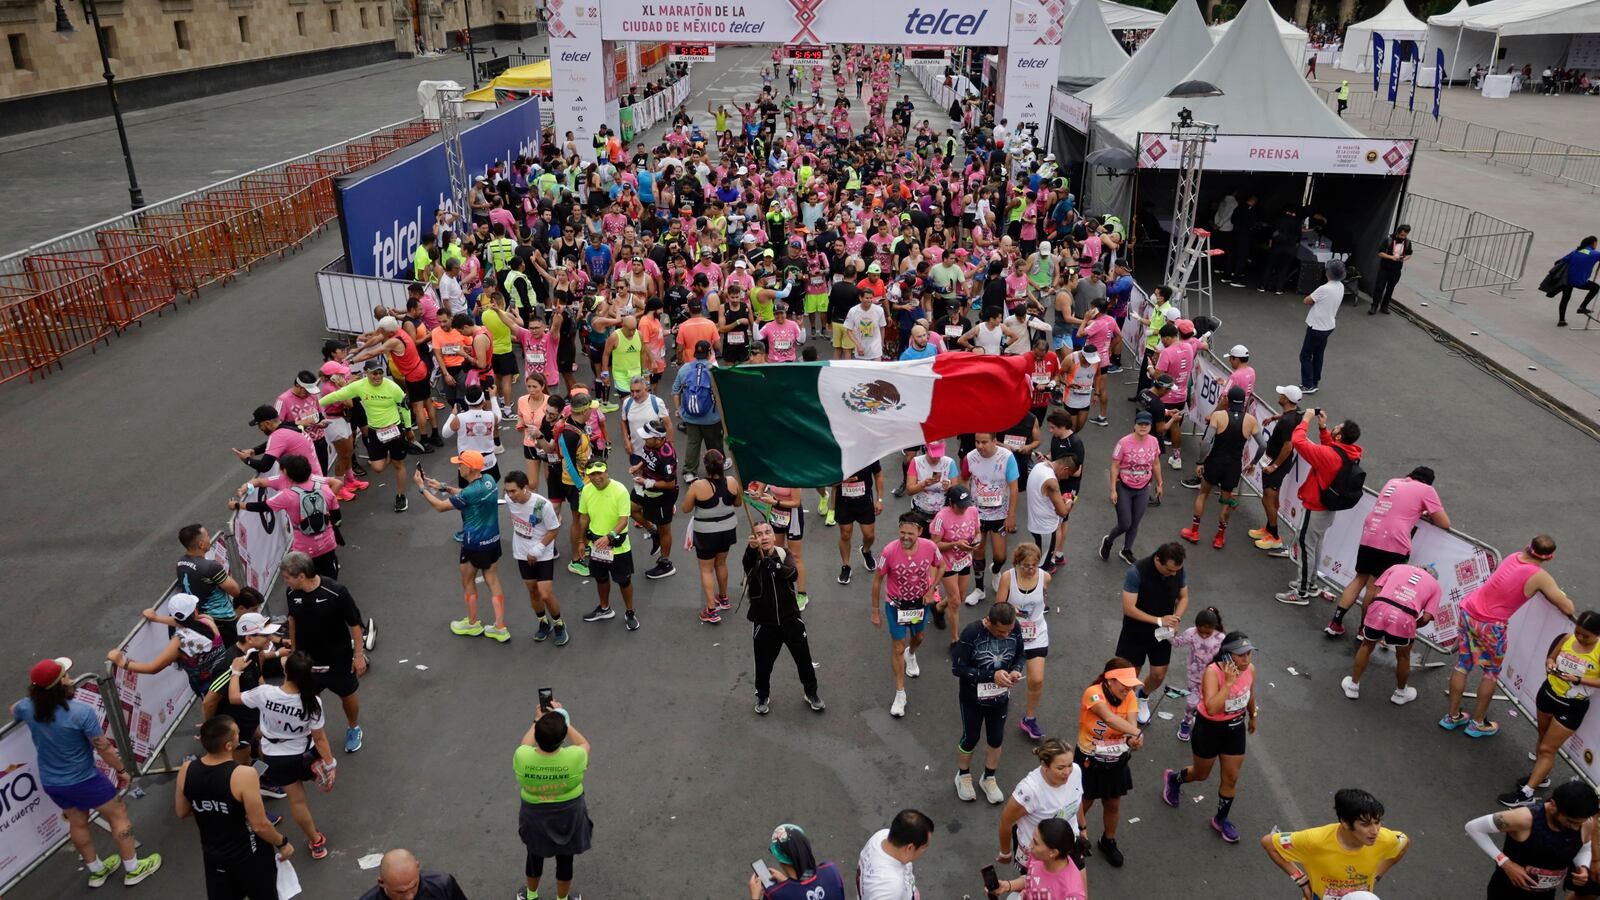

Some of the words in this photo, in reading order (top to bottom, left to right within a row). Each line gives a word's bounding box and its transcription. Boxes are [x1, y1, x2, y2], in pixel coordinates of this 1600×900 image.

[642, 5, 655, 16] XL
[715, 6, 728, 17] DE
[733, 6, 745, 17] LA
[622, 21, 663, 32] CIUDAD
[666, 22, 680, 32] DE
[683, 19, 726, 33] MÉXICO
[729, 21, 765, 34] telcel
[904, 8, 988, 35] telcel
[561, 51, 592, 62] telcel
[1017, 57, 1048, 69] telcel
[1249, 148, 1300, 160] PRENSA
[373, 206, 421, 279] telcel
